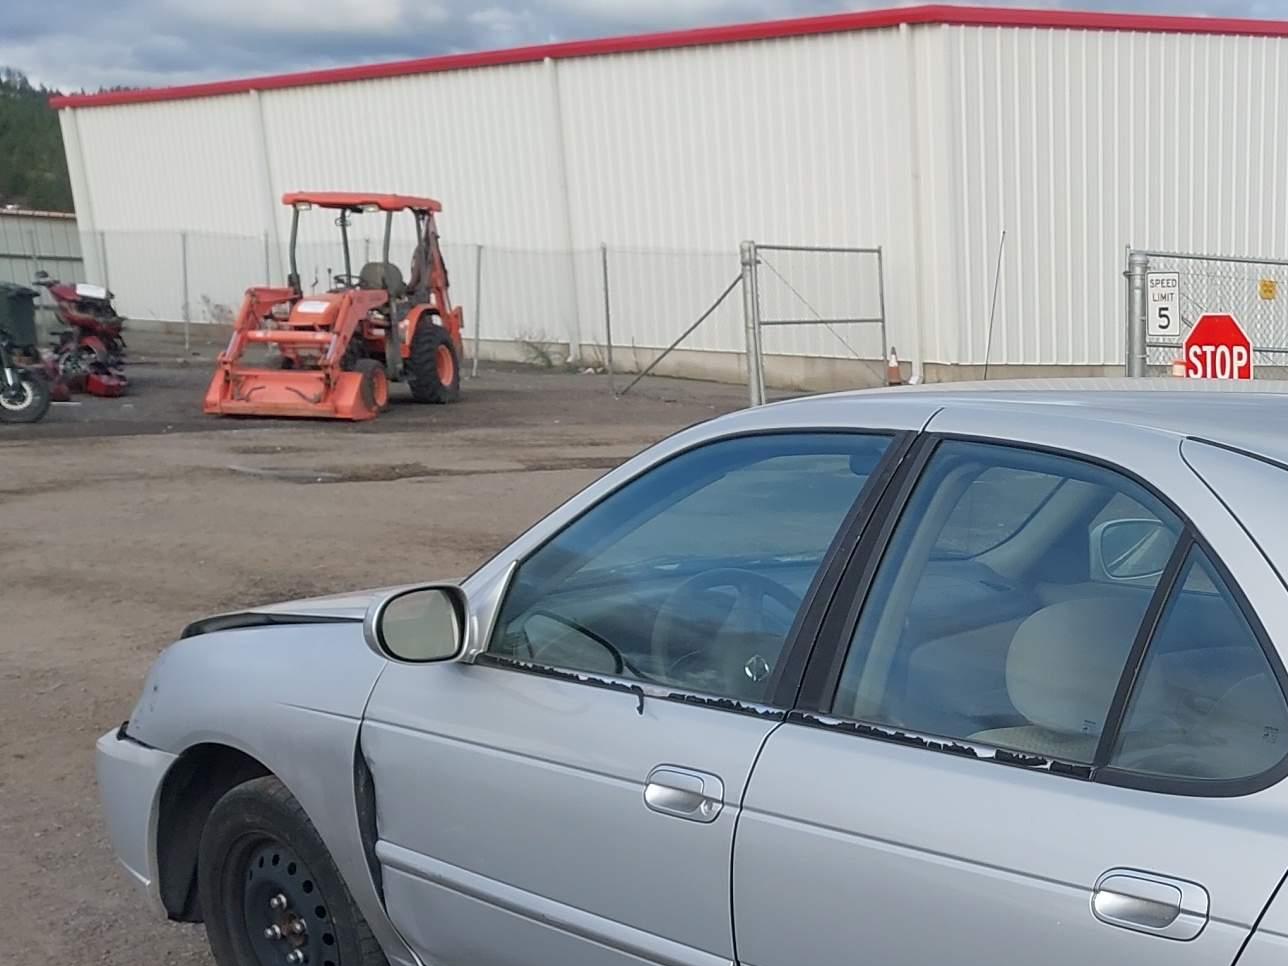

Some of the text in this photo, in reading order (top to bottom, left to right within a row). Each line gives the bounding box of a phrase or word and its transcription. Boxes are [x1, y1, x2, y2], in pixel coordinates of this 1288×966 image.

[1149, 278, 1177, 288] SPEED
[1152, 292, 1175, 302] LIMIT
[1158, 306, 1171, 329] 5
[1188, 345, 1248, 379] STOP
